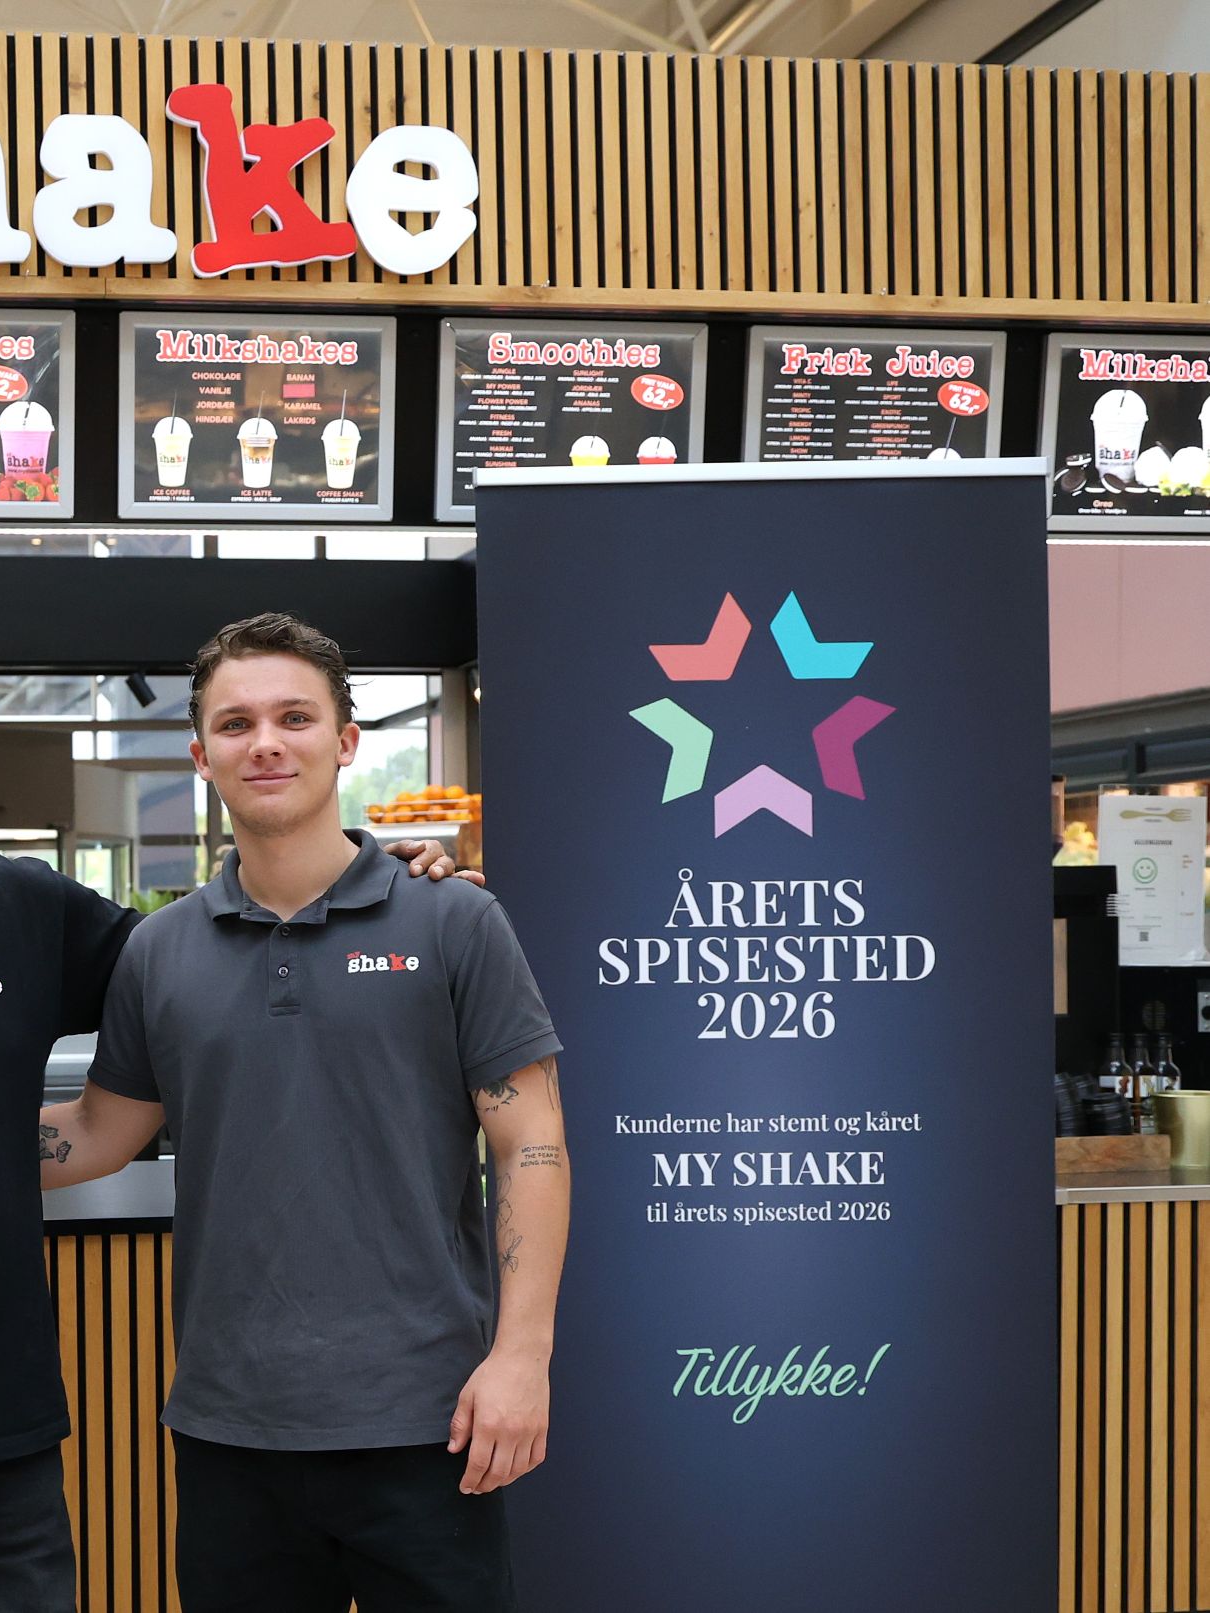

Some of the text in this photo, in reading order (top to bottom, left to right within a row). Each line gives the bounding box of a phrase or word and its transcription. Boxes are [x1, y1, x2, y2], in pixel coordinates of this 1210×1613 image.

[156, 329, 358, 365] Milkshakes
[488, 332, 661, 368] Smoothies
[781, 343, 975, 379] Frisk Juice
[1078, 349, 1210, 383] Milksha
[191, 372, 242, 381] CHOKOLADE
[286, 373, 315, 382] BANAN
[199, 386, 232, 395] VANILJE
[195, 401, 236, 410] JORDBÆR
[284, 401, 322, 410] KARAMEL
[195, 415, 234, 424] HINDBÆR
[283, 416, 317, 425] LAKRIDS
[664, 868, 865, 928] ÅRETS
[347, 953, 420, 974] shake
[598, 934, 936, 986] SPISESTED
[697, 991, 836, 1040] 2026
[615, 1111, 923, 1136] Kunderne har stemt og kåret
[651, 1151, 885, 1187] MY SHAKE
[646, 1201, 891, 1226] til årets spisested 2026
[672, 1343, 891, 1425] Tillykke!
